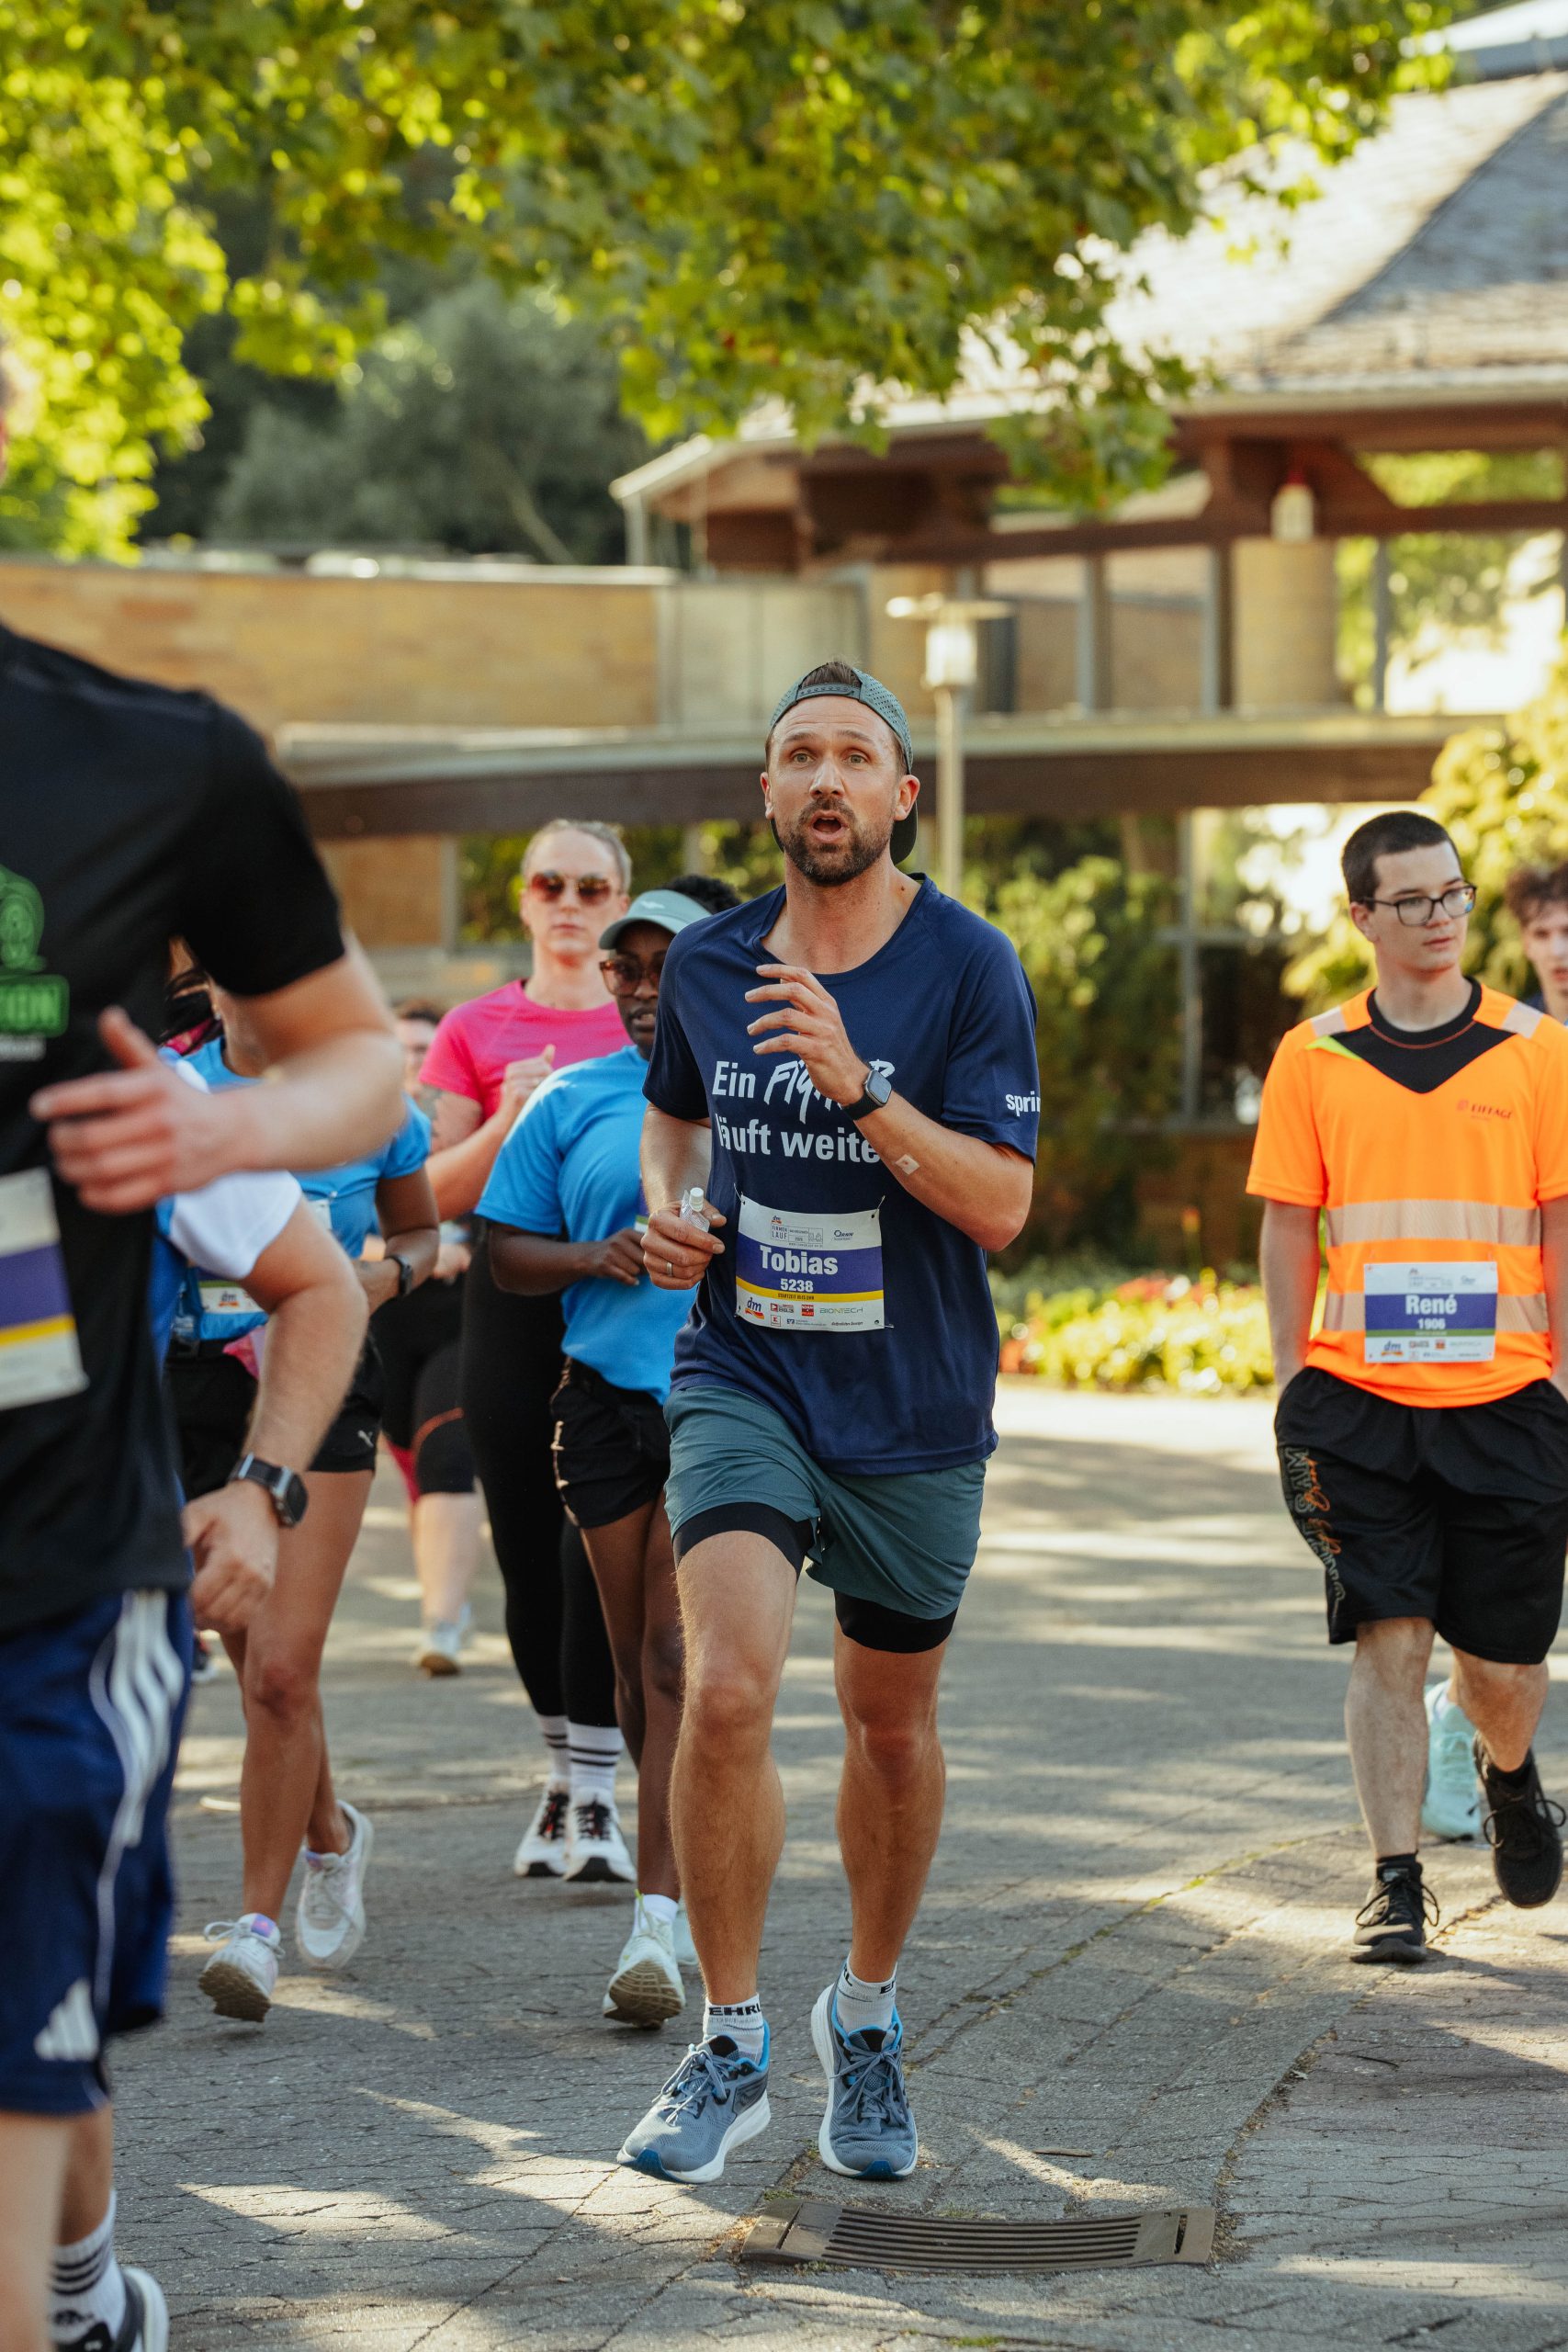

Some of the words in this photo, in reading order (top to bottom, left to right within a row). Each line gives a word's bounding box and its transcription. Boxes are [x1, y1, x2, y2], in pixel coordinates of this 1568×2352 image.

[712, 1060, 756, 1099] Ein
[781, 1126, 881, 1164] weite
[772, 1231, 787, 1240] LAUF
[760, 1244, 839, 1276] Tobias
[780, 1278, 814, 1293] 5238
[747, 1296, 762, 1312] dm
[819, 1306, 863, 1314] BIONTECH
[1405, 1294, 1458, 1315] René
[1384, 1340, 1402, 1352] dm
